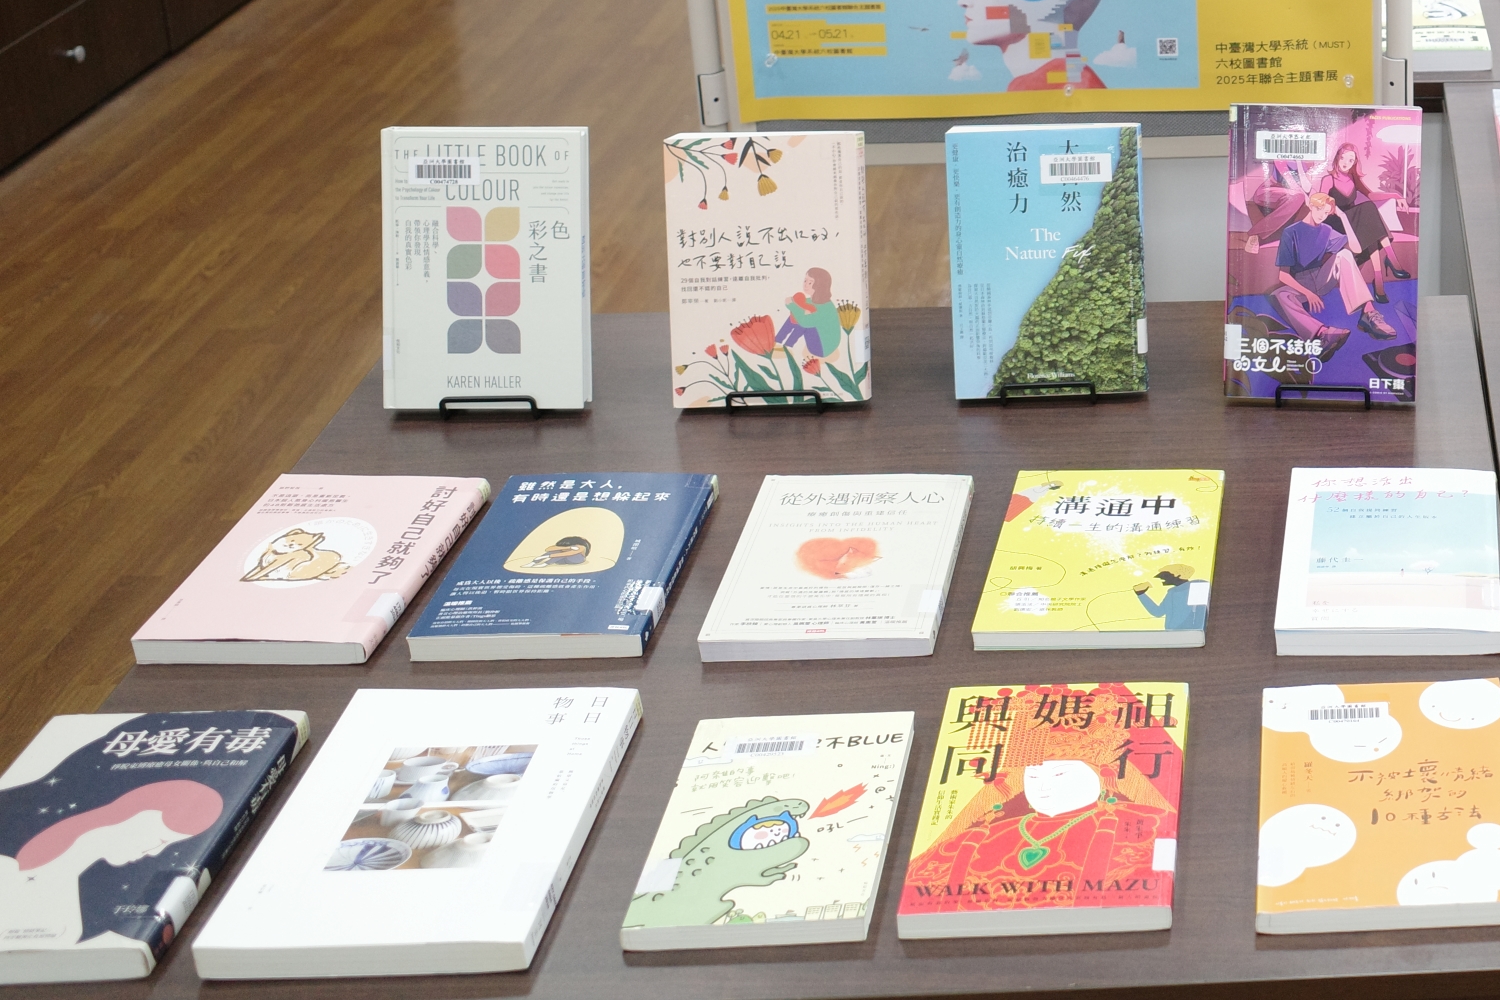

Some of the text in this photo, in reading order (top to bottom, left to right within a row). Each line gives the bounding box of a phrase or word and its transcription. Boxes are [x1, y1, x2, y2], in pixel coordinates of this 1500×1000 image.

[1215, 57, 1282, 70] 六校圖書館
[1216, 70, 1338, 86] 2025年聯合主題書展
[496, 144, 547, 167] BOOK
[554, 150, 570, 161] OF
[1007, 141, 1029, 214] 治癒力
[1030, 227, 1061, 242] The
[1005, 246, 1057, 261] Nature
[447, 375, 522, 389] KAREN HALLER
[512, 491, 671, 504] 有時還是想躲起來
[779, 491, 945, 506] 從外遇洞察人心
[1053, 495, 1177, 517] 溝通中
[367, 486, 459, 585] 討好自己就夠了
[948, 691, 1178, 734] 與媽祖
[102, 726, 273, 758] 母愛有毒
[915, 878, 1160, 898] WALK WITH MAZU
